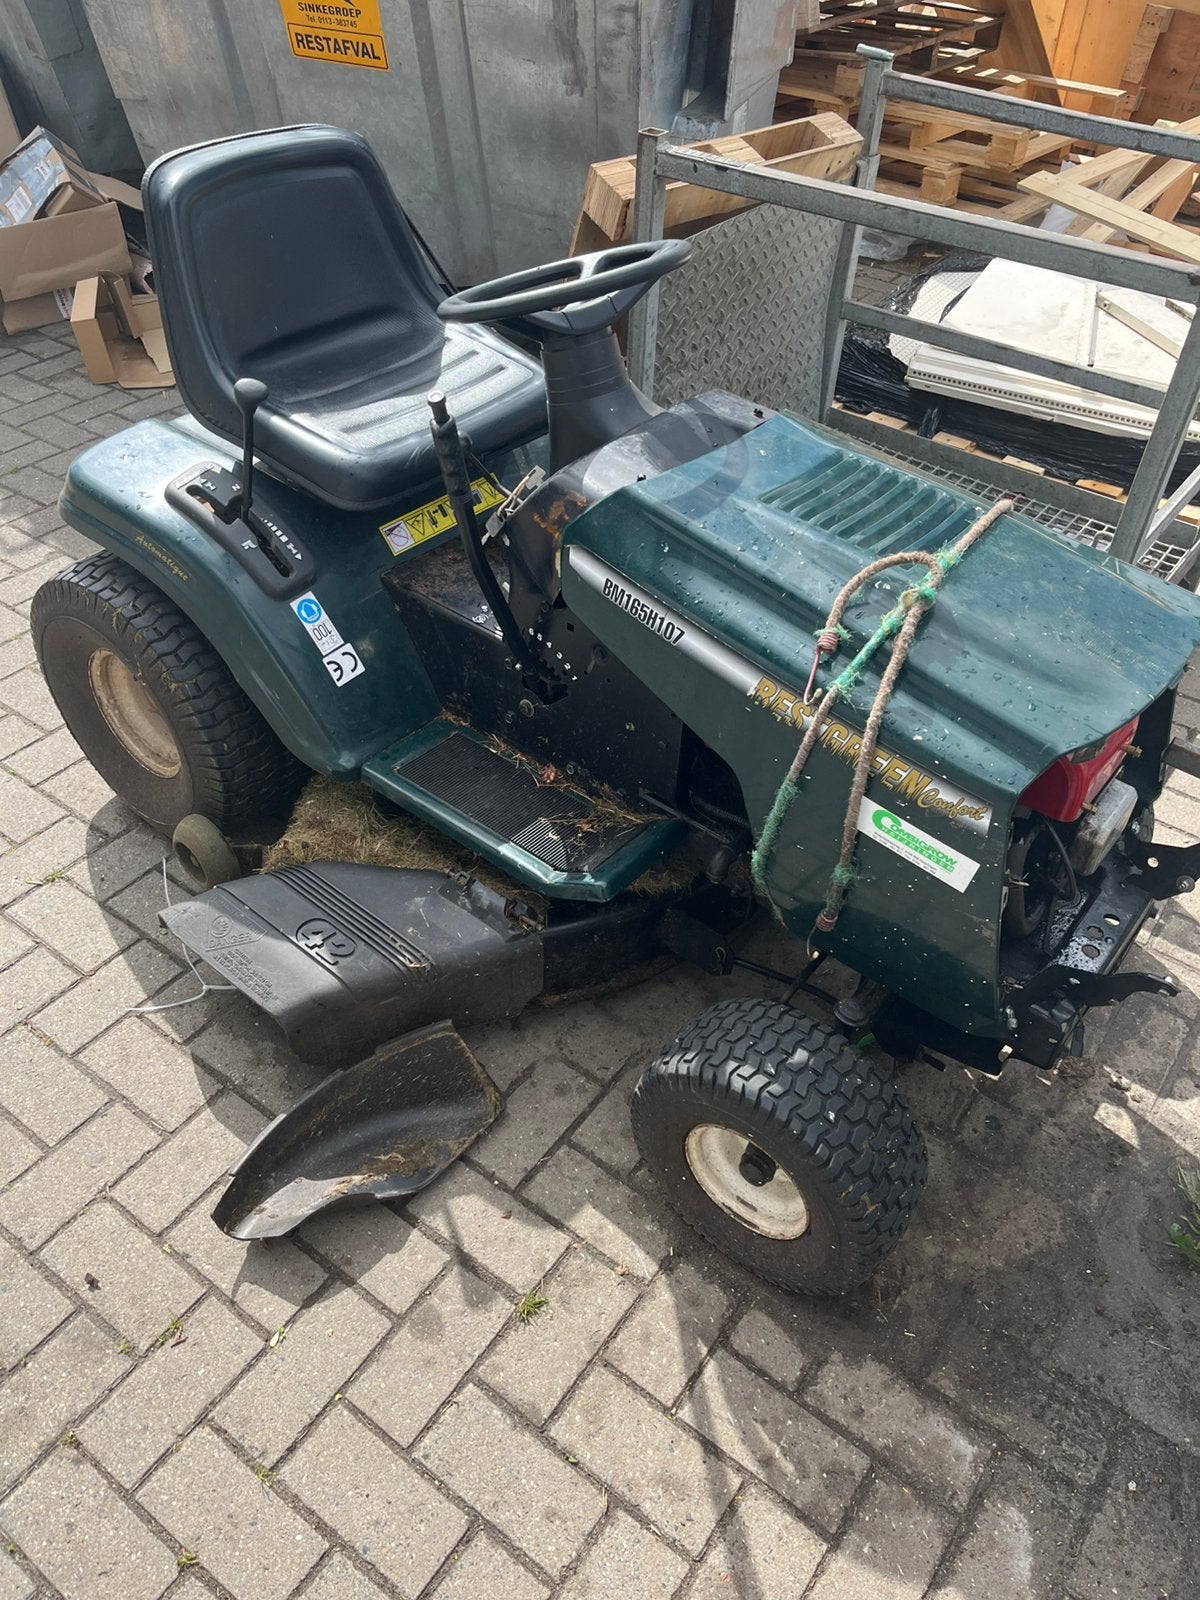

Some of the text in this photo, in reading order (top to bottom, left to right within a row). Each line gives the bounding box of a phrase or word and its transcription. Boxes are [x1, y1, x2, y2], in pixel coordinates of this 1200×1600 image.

[297, 2, 361, 18] SINKEGROEP
[306, 14, 317, 23] Tel.
[294, 32, 381, 60] RESTAFVAL
[135, 535, 188, 581] Automatique
[602, 577, 686, 645] BM165H107
[312, 622, 333, 641] 100
[917, 788, 989, 820] Comfort
[300, 928, 353, 967] 42
